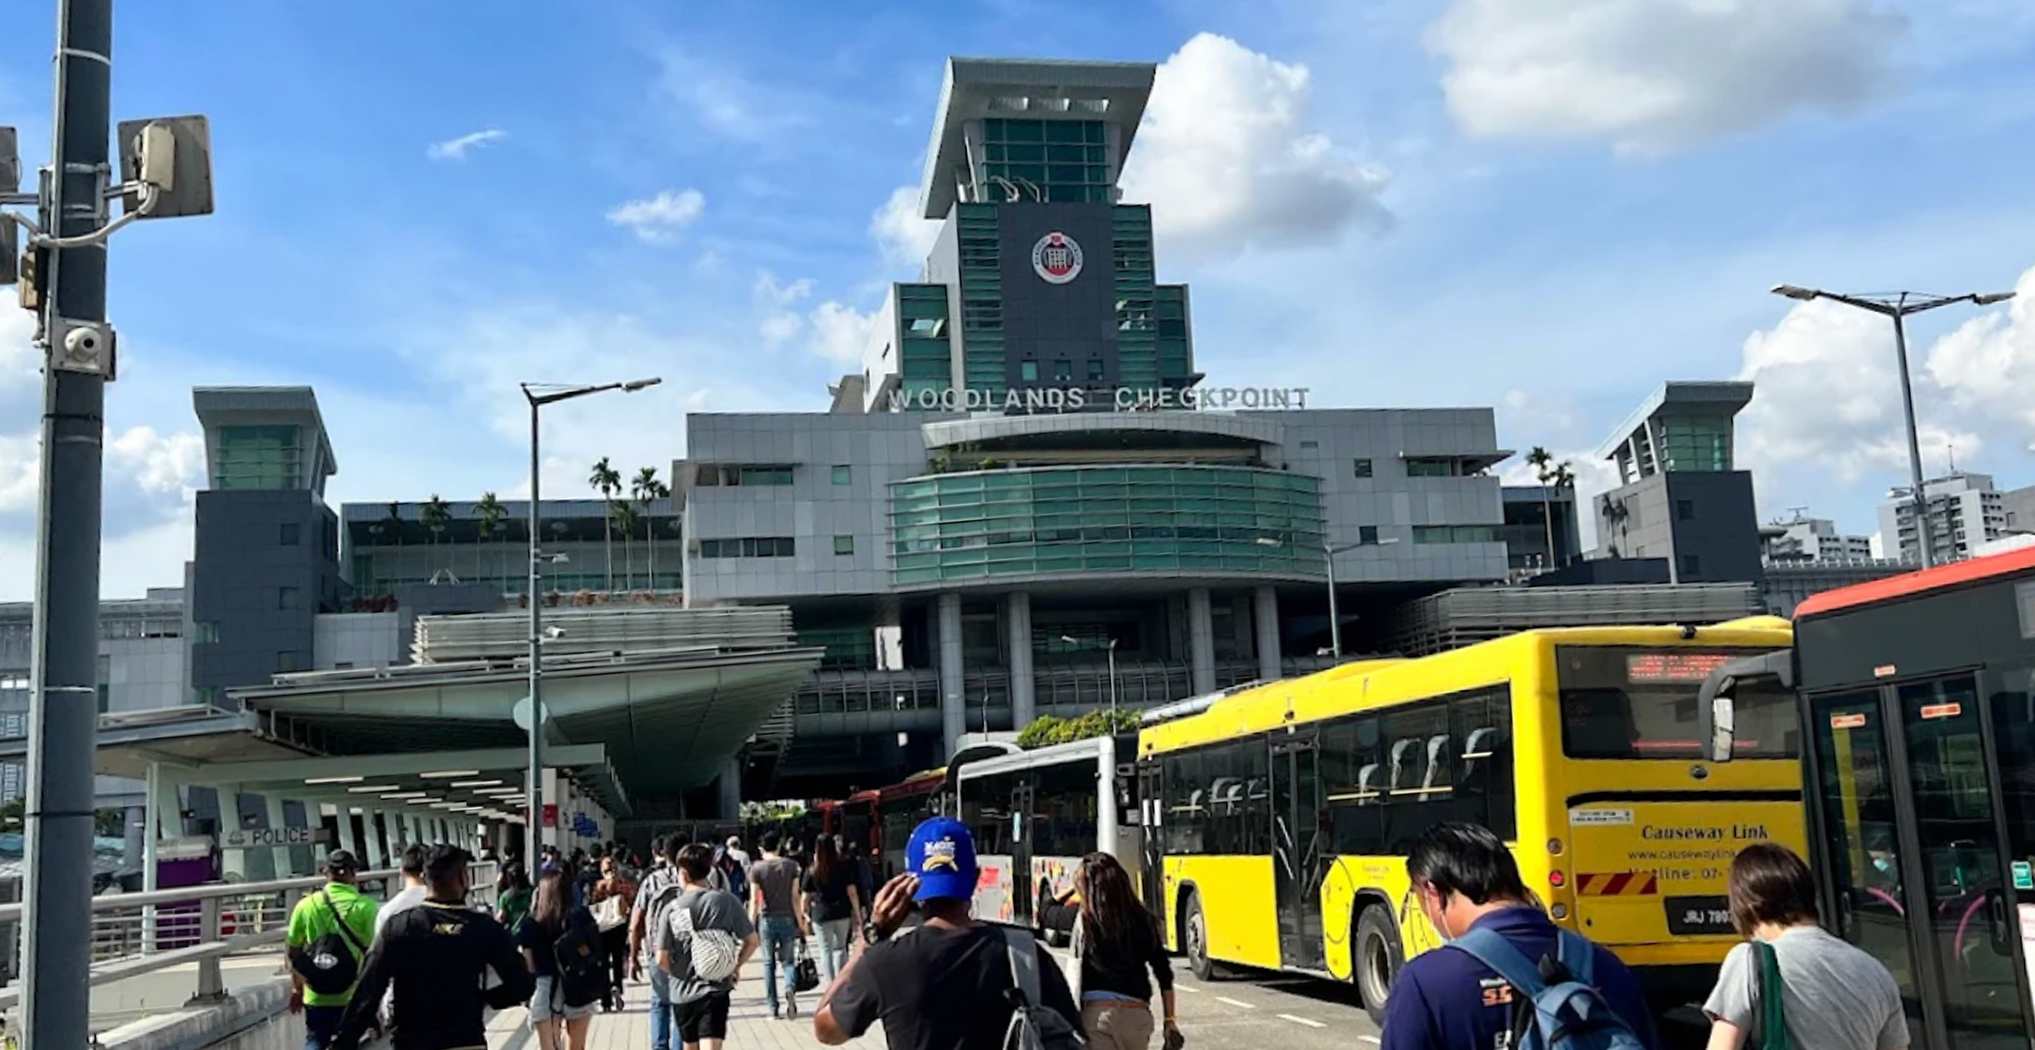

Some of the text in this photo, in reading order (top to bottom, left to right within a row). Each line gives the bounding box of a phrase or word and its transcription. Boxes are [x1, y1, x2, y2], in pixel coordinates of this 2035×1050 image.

[888, 387, 1310, 409] WOODLANDS CHECKPOINT
[252, 827, 309, 845] POLICE
[1642, 824, 1768, 841] Causeway Link
